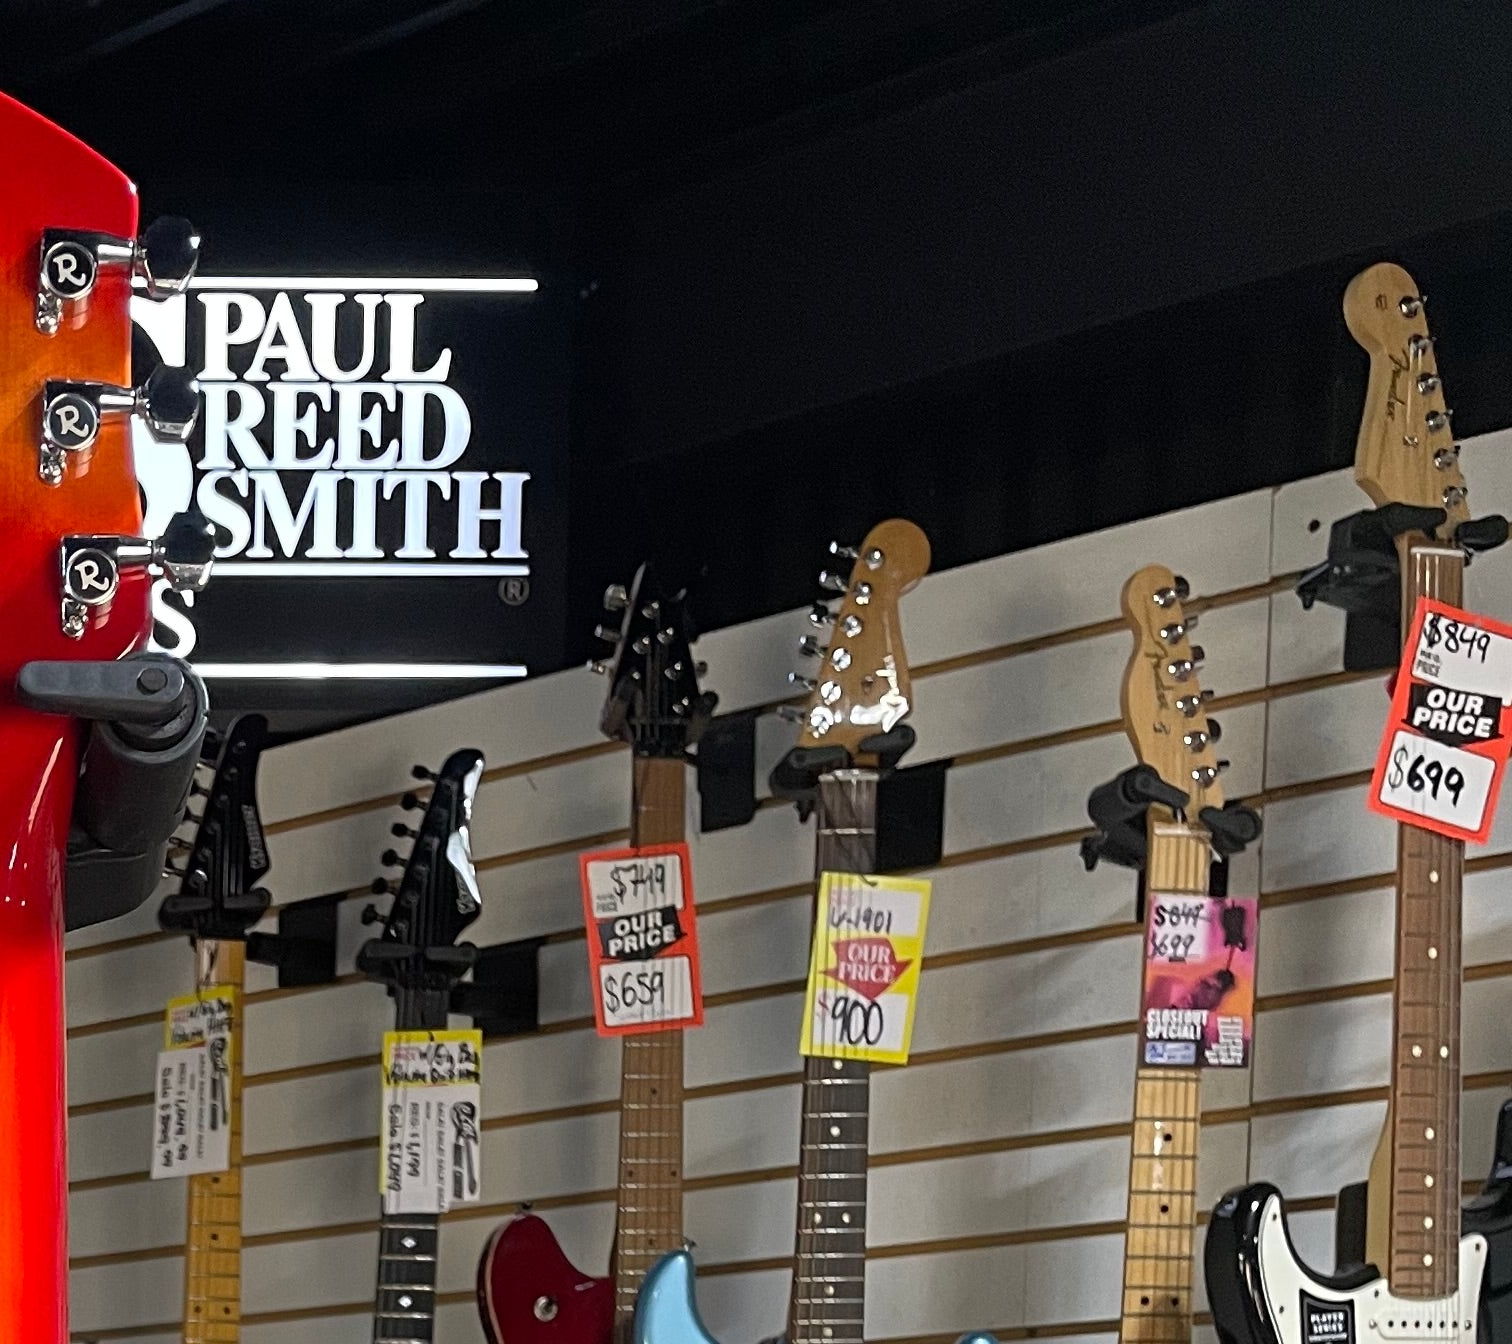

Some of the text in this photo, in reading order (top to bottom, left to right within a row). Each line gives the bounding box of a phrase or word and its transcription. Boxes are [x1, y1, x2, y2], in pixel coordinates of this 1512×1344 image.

[196, 291, 453, 383] PAUL
[192, 382, 472, 470] REED
[196, 471, 531, 559] SMITH
[1423, 613, 1492, 664] $849
[1426, 688, 1484, 716] OUR
[1412, 706, 1494, 739] PRICE
[1388, 746, 1465, 808] $699
[607, 924, 677, 957] PRICE
[613, 911, 664, 938] OUR
[847, 942, 892, 963] OUR
[838, 961, 897, 985] PRICE
[604, 971, 664, 1014] $659
